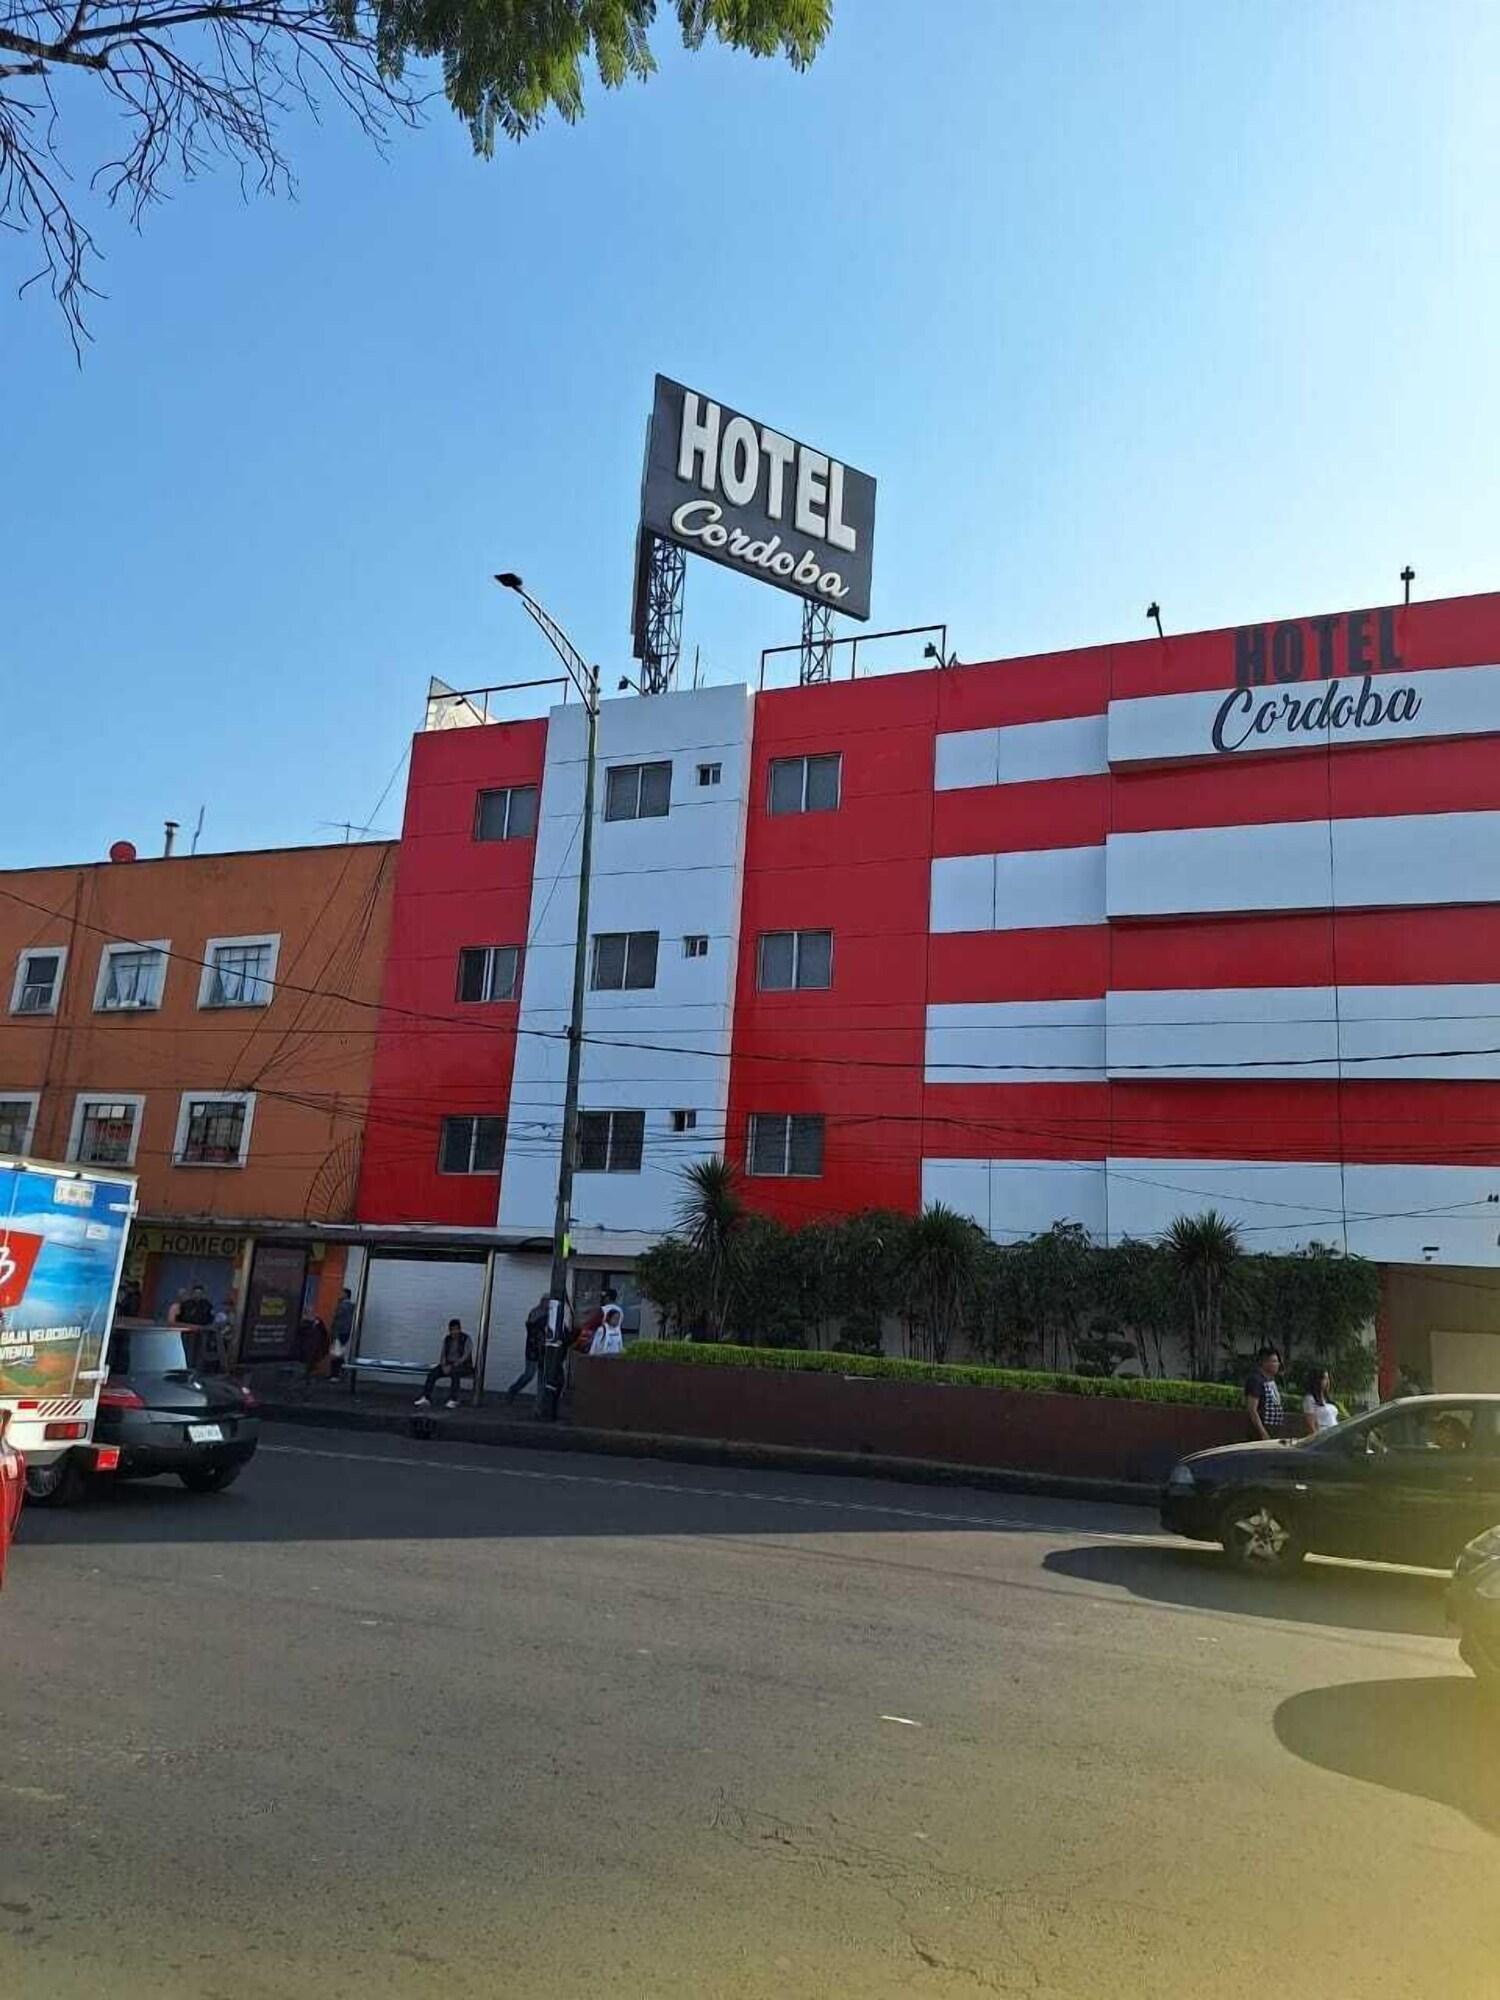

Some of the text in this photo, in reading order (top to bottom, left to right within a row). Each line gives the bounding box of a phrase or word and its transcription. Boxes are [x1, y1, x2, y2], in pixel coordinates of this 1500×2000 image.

[678, 391, 856, 552] HOTEL
[671, 499, 850, 599] Cordoba
[1234, 608, 1403, 687] HOTEL
[1211, 675, 1422, 752] Cordoba
